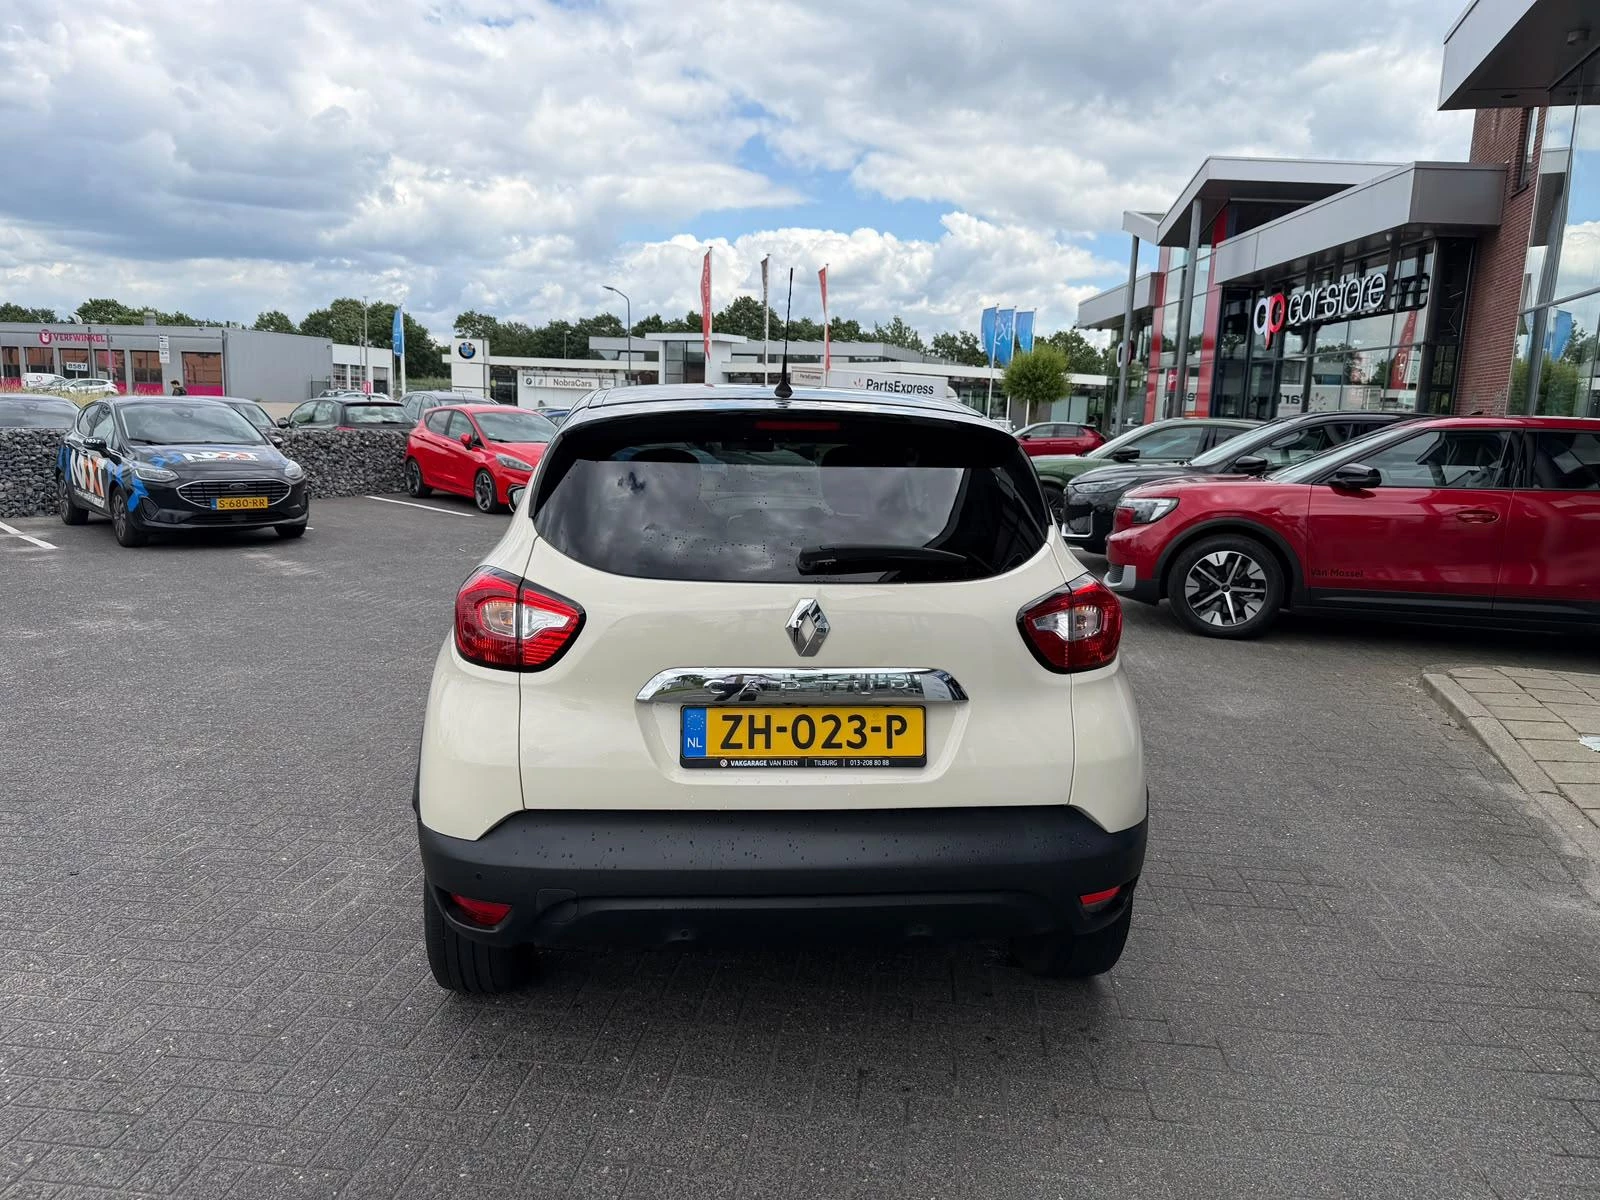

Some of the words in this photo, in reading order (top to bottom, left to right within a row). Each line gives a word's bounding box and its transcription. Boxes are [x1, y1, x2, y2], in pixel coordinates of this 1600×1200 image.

[53, 333, 106, 343] VERFWINKEL
[553, 378, 593, 387] NobraCars
[866, 378, 934, 395] PartsExpress
[219, 498, 266, 509] S-680-RR
[720, 714, 908, 750] ZH-023-P
[687, 737, 703, 748] NL
